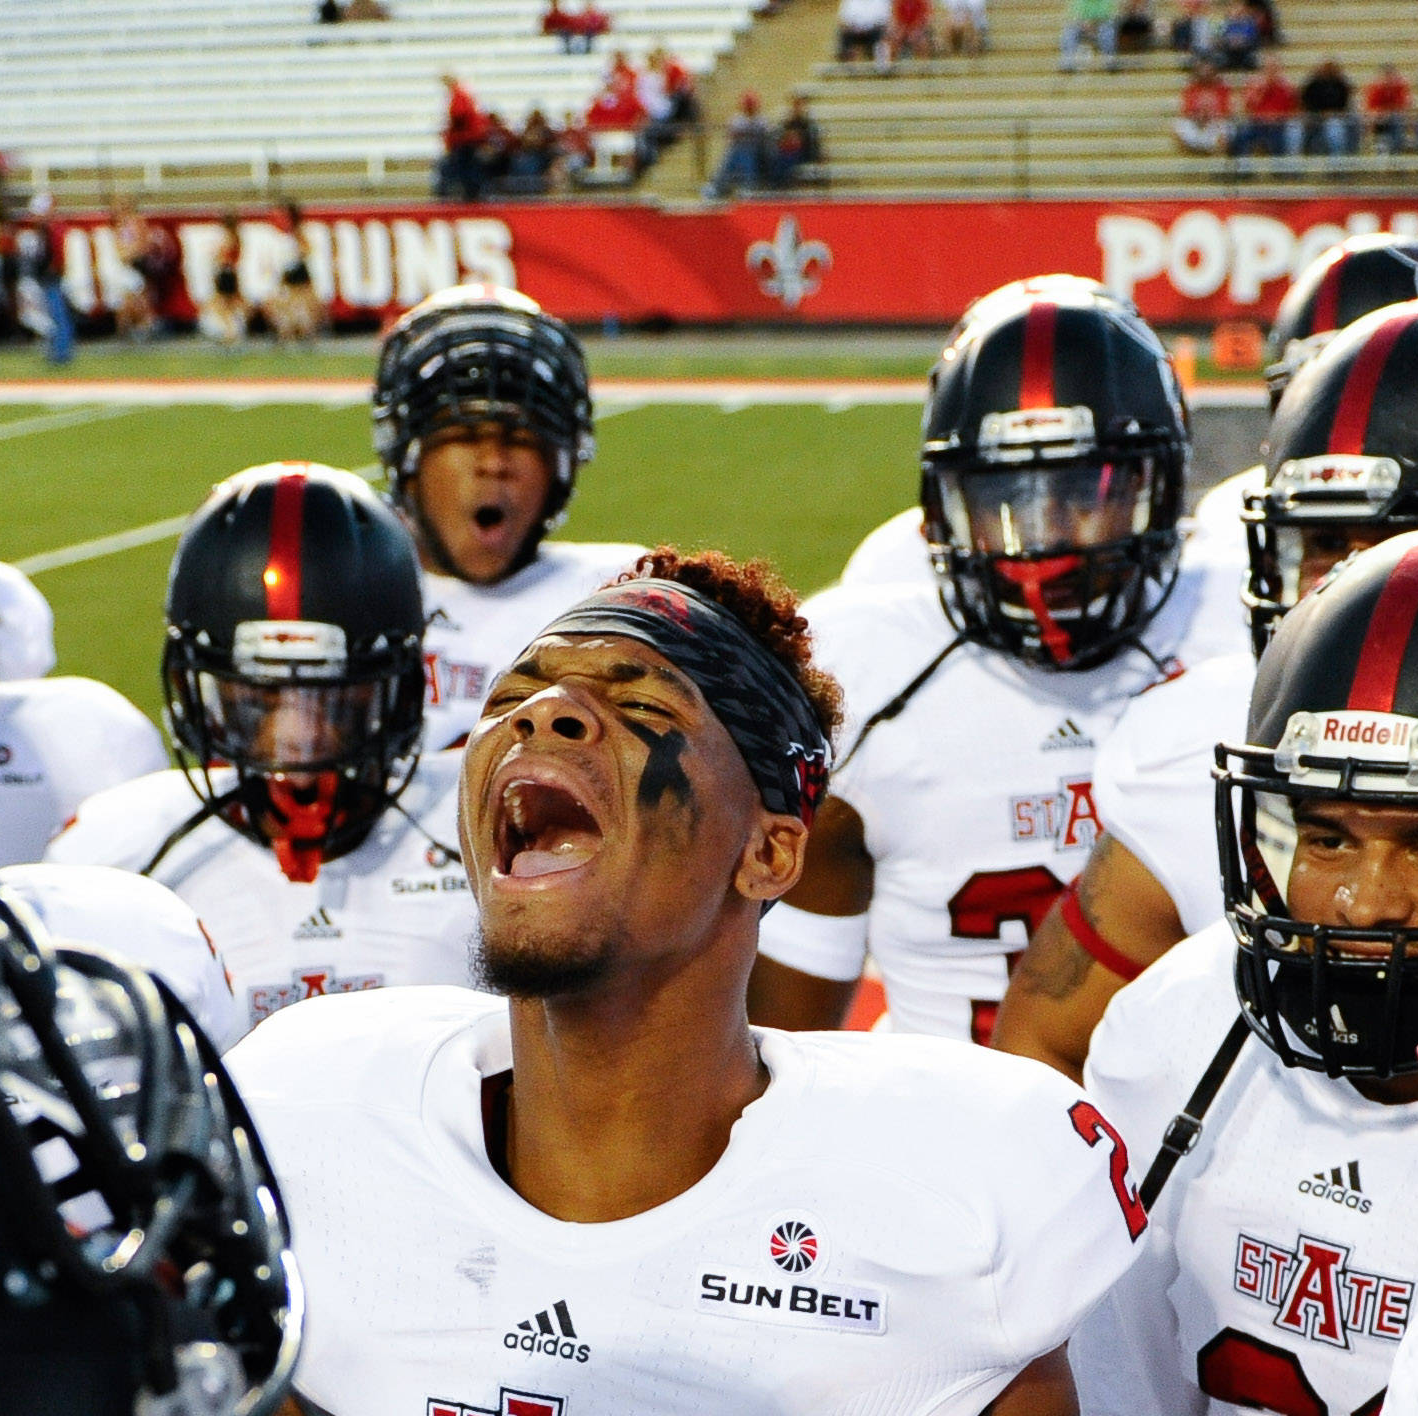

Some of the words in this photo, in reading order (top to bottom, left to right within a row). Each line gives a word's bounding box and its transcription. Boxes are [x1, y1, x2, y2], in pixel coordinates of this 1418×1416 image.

[1323, 718, 1409, 746] Riddell
[1067, 1100, 1149, 1242] 2
[1298, 1179, 1373, 1214] adidas
[701, 1273, 783, 1309] SUN
[789, 1285, 879, 1321] BELT
[1234, 1233, 1416, 1350] STATE
[503, 1332, 591, 1363] adidas
